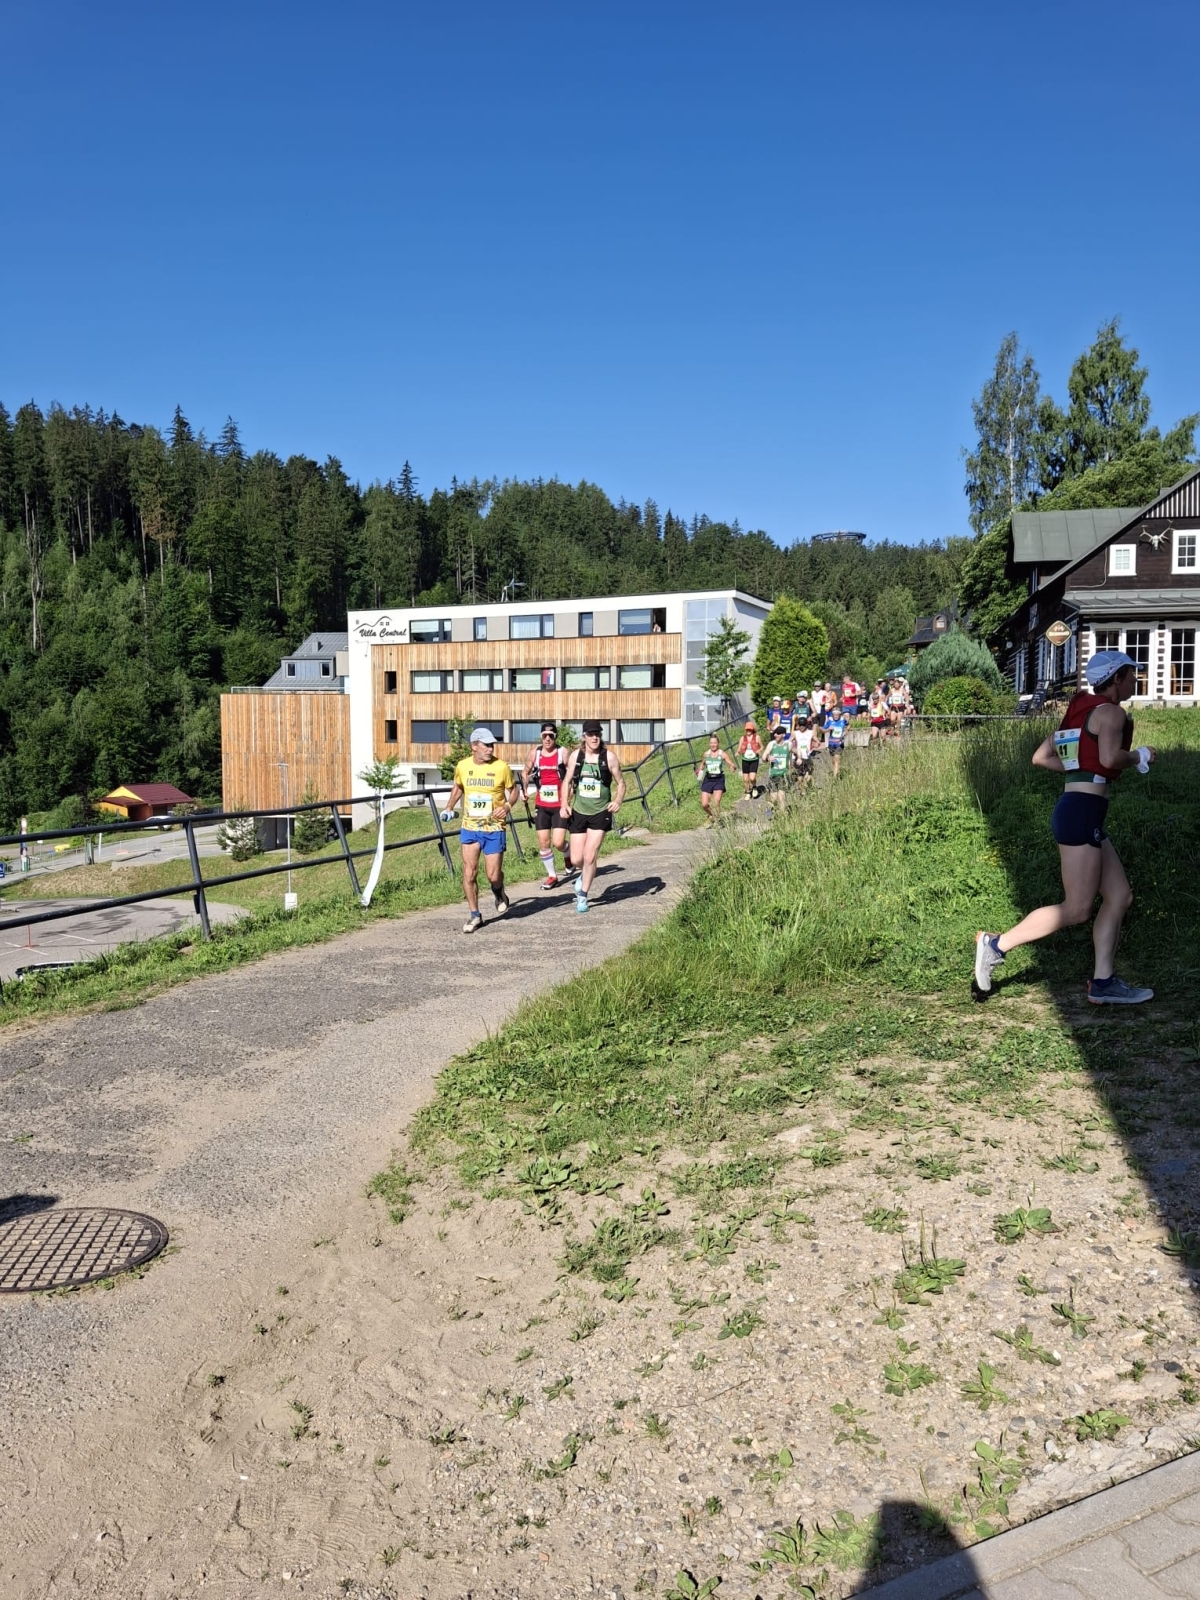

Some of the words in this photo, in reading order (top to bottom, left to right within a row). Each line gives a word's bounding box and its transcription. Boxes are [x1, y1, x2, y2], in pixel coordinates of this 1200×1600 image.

[359, 628, 376, 637] Villa
[379, 628, 406, 638] Central
[466, 778, 494, 787] ECUADOR
